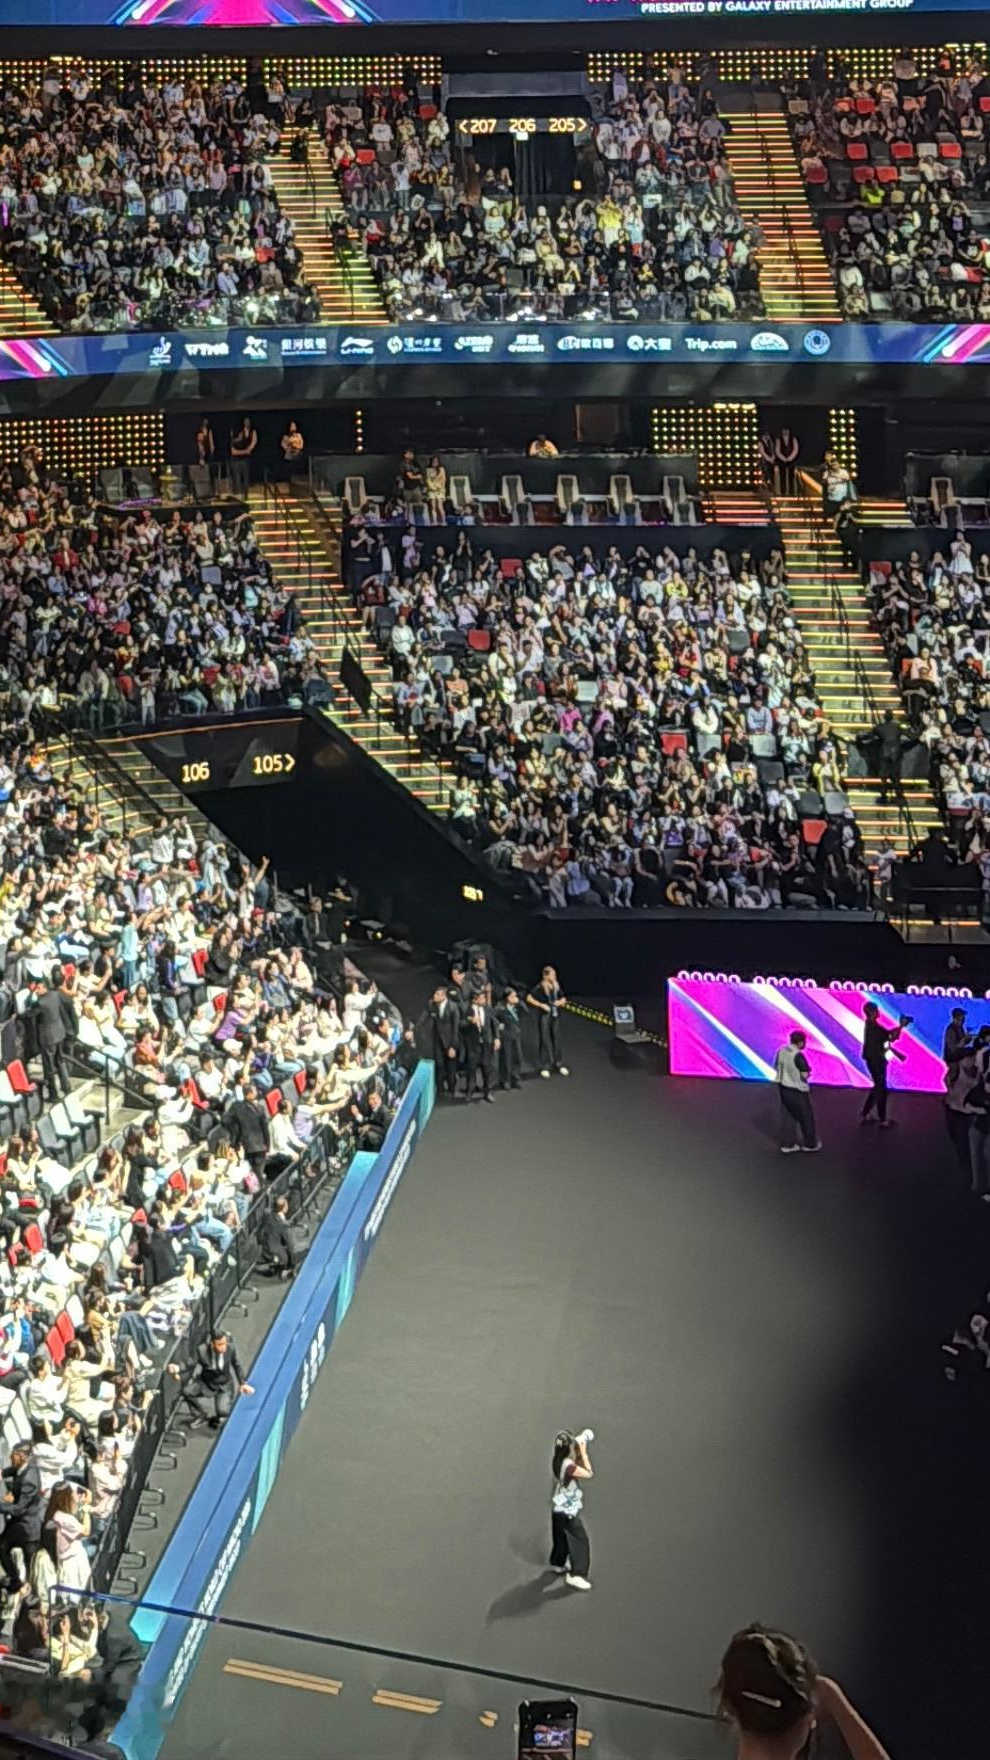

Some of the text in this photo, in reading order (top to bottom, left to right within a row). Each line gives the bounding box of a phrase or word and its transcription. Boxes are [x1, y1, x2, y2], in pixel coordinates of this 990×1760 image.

[641, 1, 705, 14] PRESENTED
[708, 1, 722, 13] BY
[725, 0, 772, 12] GALAXY
[470, 117, 576, 134] 207 206 205
[685, 337, 737, 352] Trip.com
[181, 754, 283, 783] 106 105
